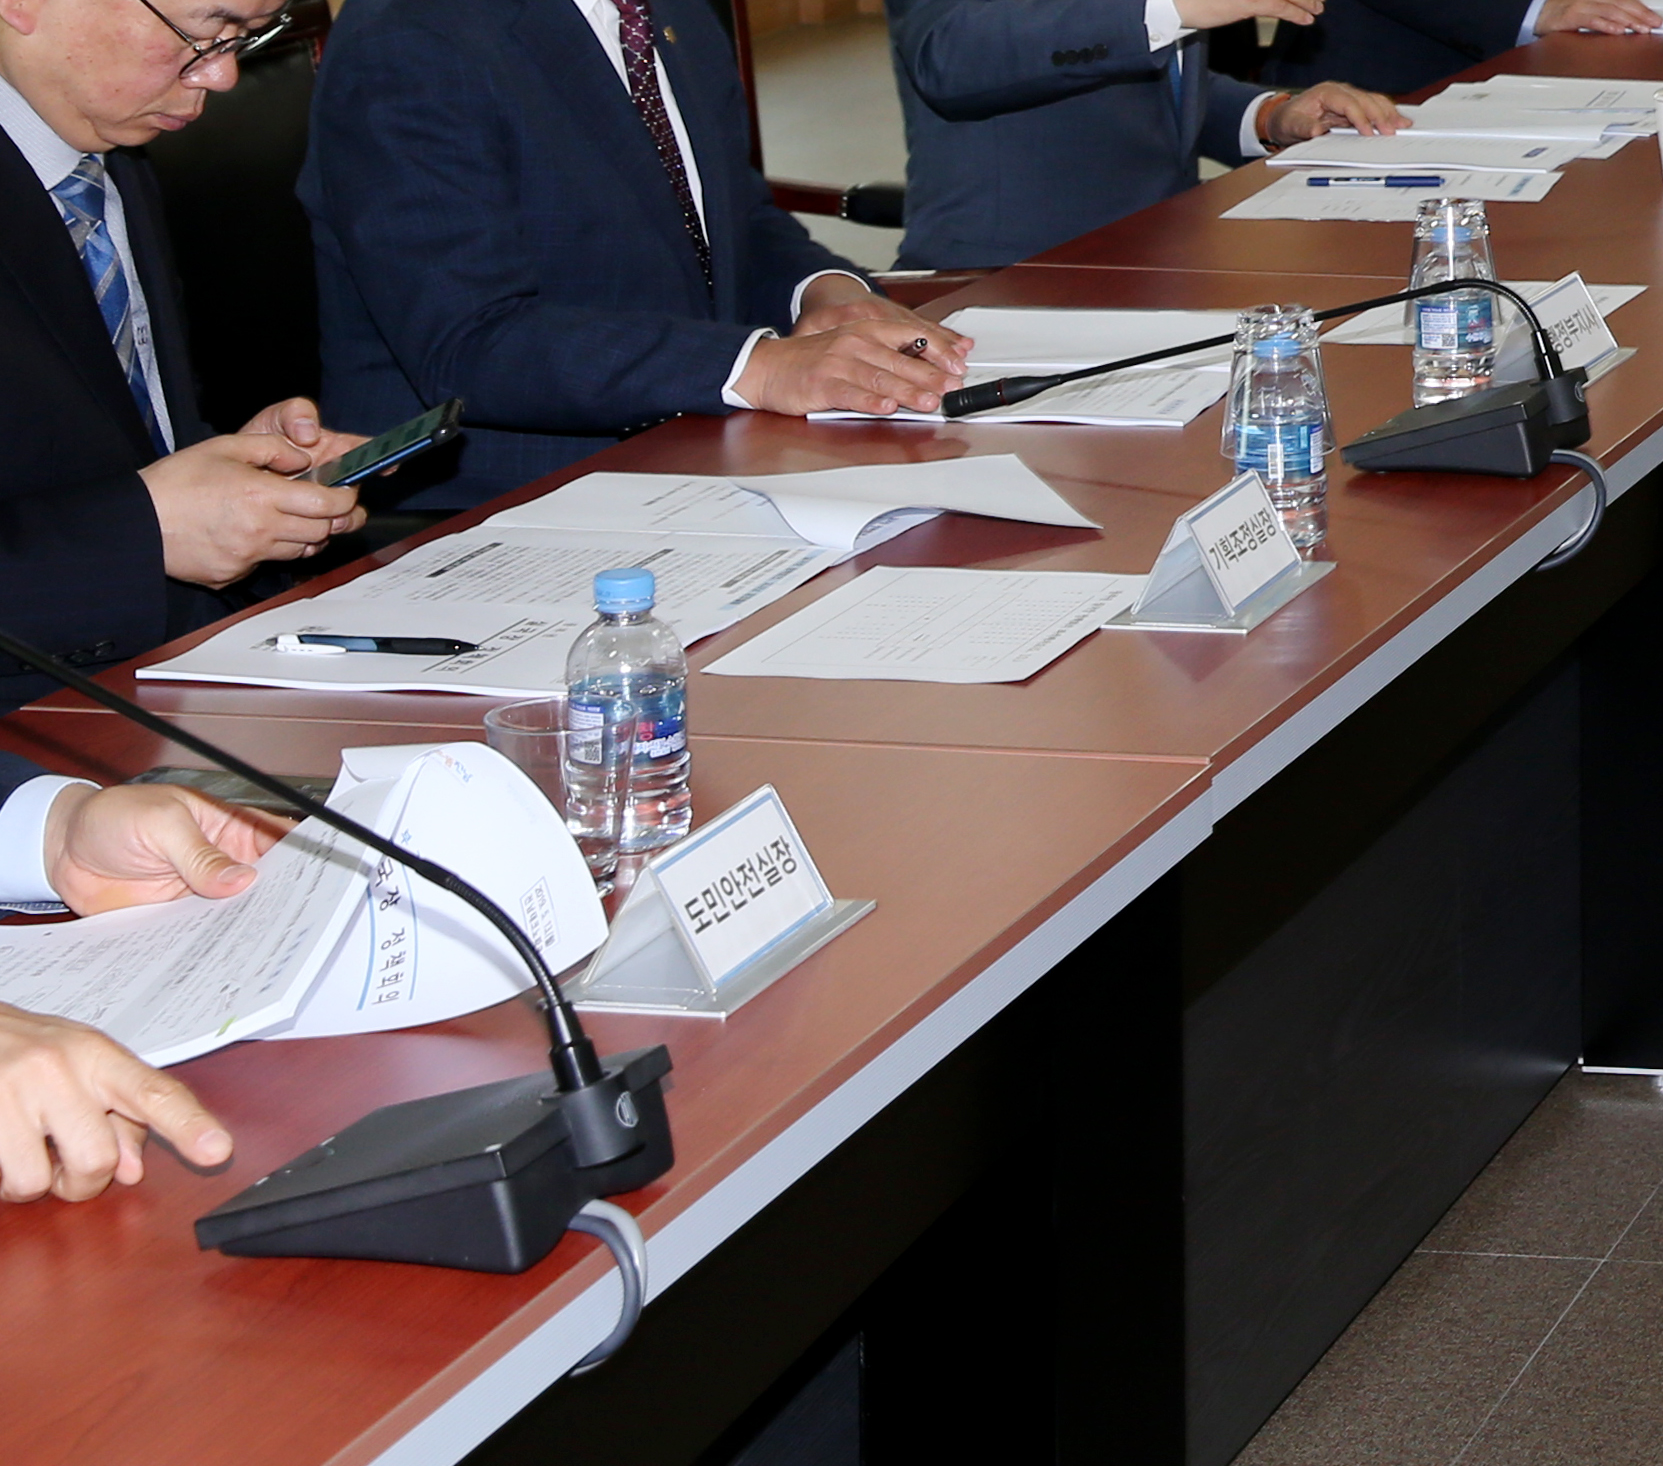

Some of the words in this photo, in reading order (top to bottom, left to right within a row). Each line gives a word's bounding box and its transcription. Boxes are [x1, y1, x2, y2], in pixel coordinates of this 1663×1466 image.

[1208, 507, 1277, 571] 기획조정실장
[684, 835, 798, 935] 도민안전실장
[371, 926, 408, 1007] 정책회의
